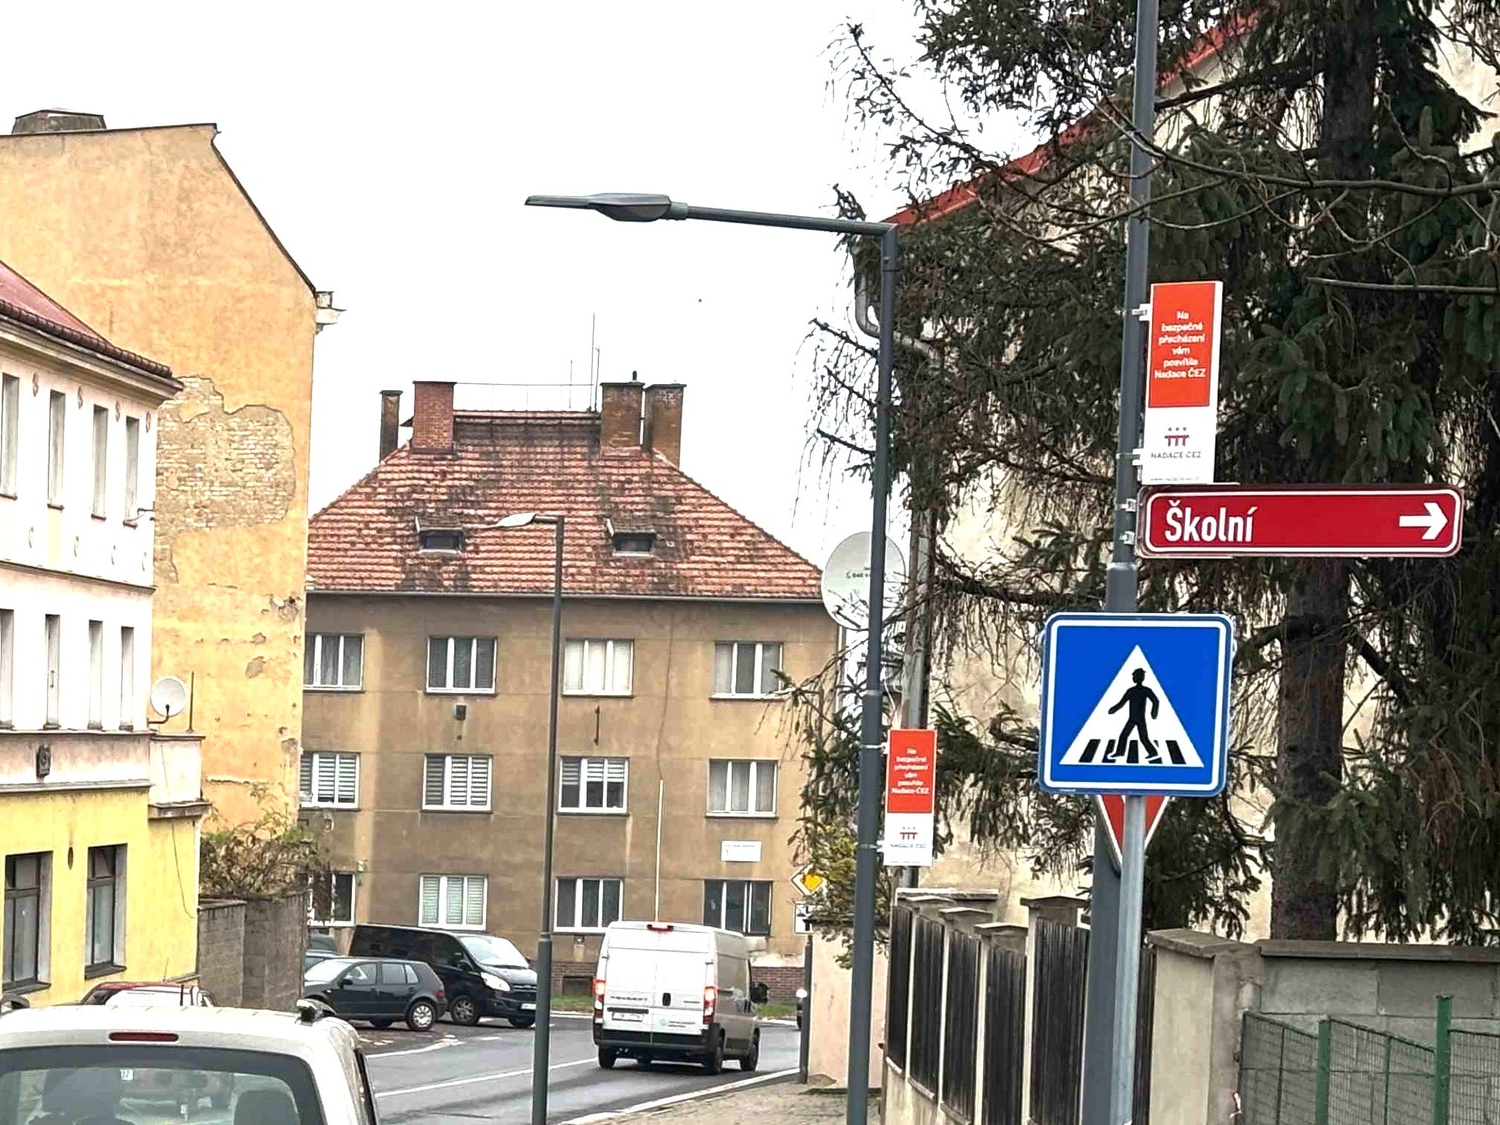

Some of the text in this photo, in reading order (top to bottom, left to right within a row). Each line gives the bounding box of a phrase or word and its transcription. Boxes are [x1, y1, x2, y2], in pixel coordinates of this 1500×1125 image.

[1177, 310, 1190, 320] Na
[1154, 367, 1207, 379] Nadace ČEZ
[1165, 499, 1258, 542] Školní
